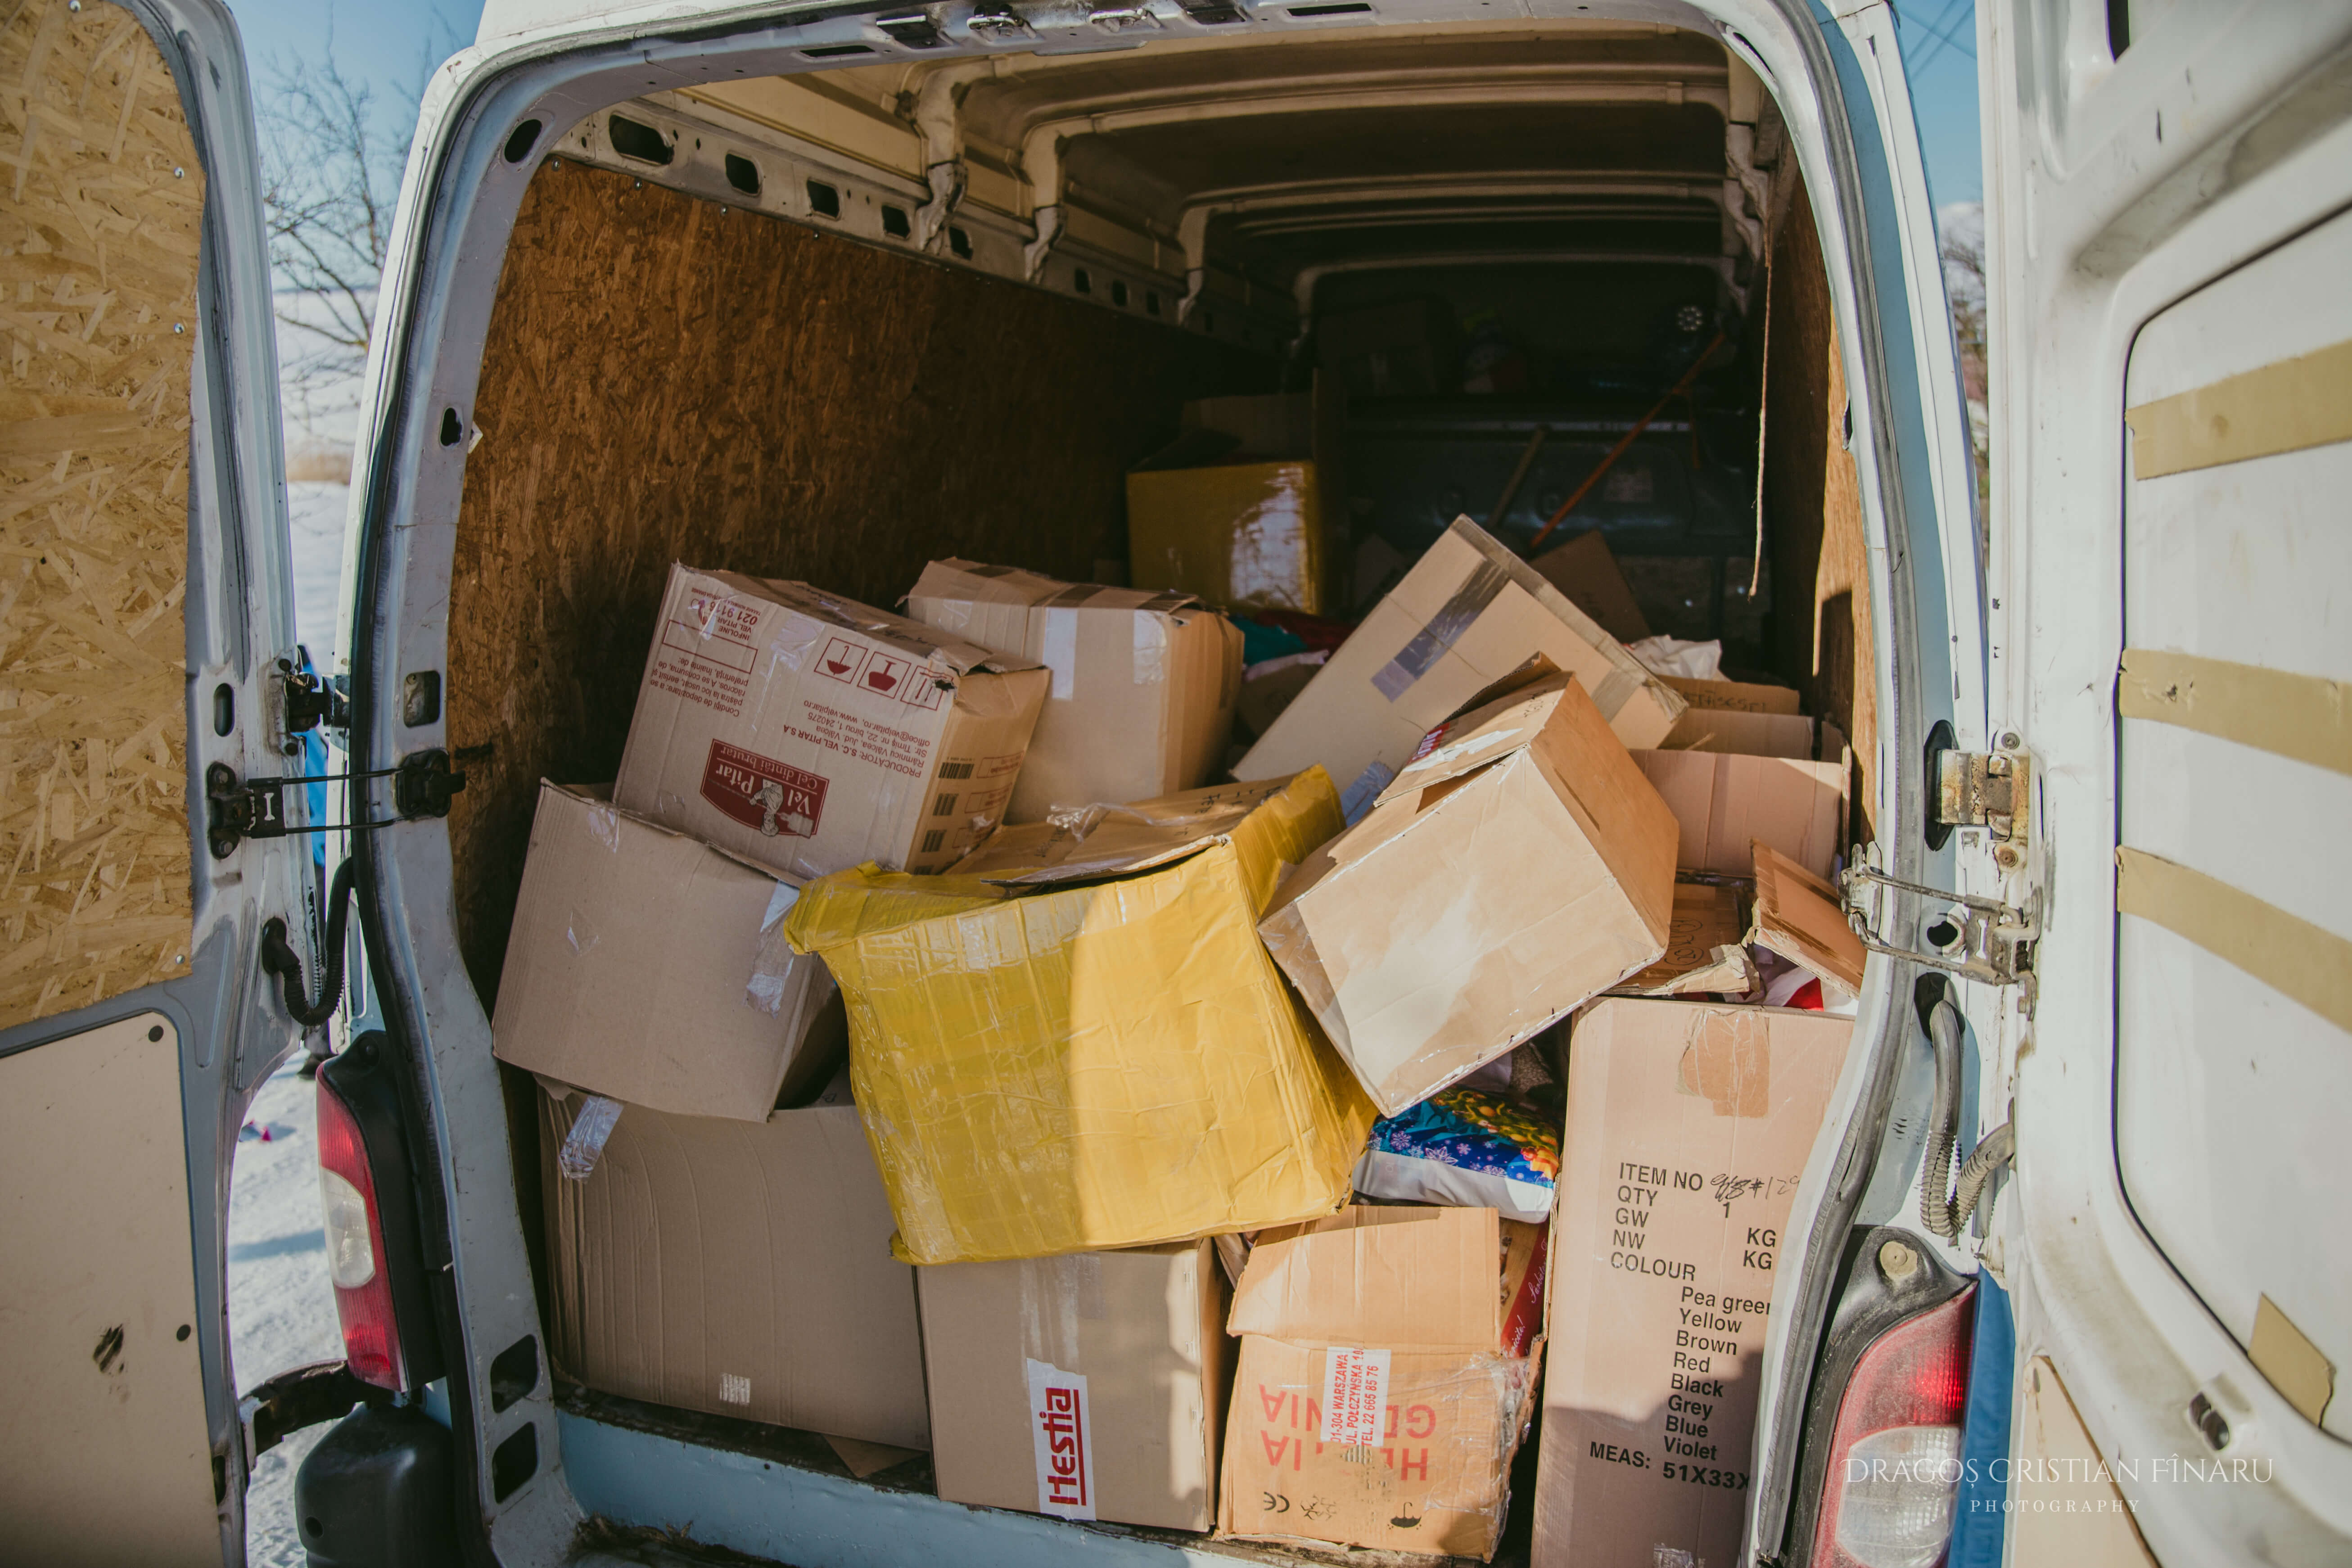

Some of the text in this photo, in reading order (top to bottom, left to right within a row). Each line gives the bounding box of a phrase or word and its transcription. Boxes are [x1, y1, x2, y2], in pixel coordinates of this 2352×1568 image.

[718, 617, 751, 633] VEL PITAR
[737, 611, 758, 625] 021
[718, 626, 749, 641] INFOLINE
[658, 661, 667, 670] de
[678, 657, 689, 666] de:
[659, 672, 679, 684] aerisit
[669, 664, 700, 681] consuma,
[681, 679, 700, 691] uscat,
[701, 687, 711, 696] loc
[666, 686, 702, 704] depozitare:
[704, 699, 712, 707] de
[721, 694, 743, 706] păstra
[804, 700, 930, 747] office@velpitar.ro, www.velpitar.ro
[808, 712, 835, 728] 240275
[837, 721, 843, 730] 1,
[816, 725, 840, 741] Vâlcea
[843, 734, 858, 745] Jud.
[845, 725, 864, 737] birou
[867, 731, 878, 741] 22,
[862, 741, 888, 756] Vâlcea,
[880, 737, 889, 745] nr.
[783, 725, 921, 778] PRODUCĂTOR: S.C. VEL PITAR S.A
[890, 751, 925, 768] Râmnicu
[914, 748, 927, 758] Str.
[720, 746, 817, 790] Cel dintâi brutar
[716, 764, 810, 814] Vel Pitar
[1619, 1162, 1703, 1191] ITEM NO
[1617, 1185, 1658, 1207] QTY
[1615, 1207, 1649, 1228] GW
[1722, 1201, 1730, 1219] 1
[1613, 1229, 1645, 1250] NW
[1747, 1227, 1776, 1247] KG
[1610, 1251, 1696, 1282] COLOUR
[1743, 1249, 1772, 1270] KG
[1681, 1286, 1716, 1307] Pea
[1679, 1307, 1742, 1333] Yellow
[1676, 1329, 1738, 1356] Brown
[1673, 1351, 1711, 1373] Red
[1332, 1353, 1349, 1410] WARSZAWA
[1670, 1373, 1724, 1398] Black
[1346, 1364, 1363, 1428] POŁCZYŃSKA
[1361, 1365, 1379, 1446] TEL. 22 665 85 76
[1667, 1394, 1713, 1421] Grey
[1665, 1414, 1708, 1438] Blue
[1038, 1387, 1079, 1505] Hestia
[1345, 1428, 1359, 1445] UL.
[1664, 1435, 1717, 1461] Violet
[1589, 1441, 1750, 1491] MEAS: 51X33X
